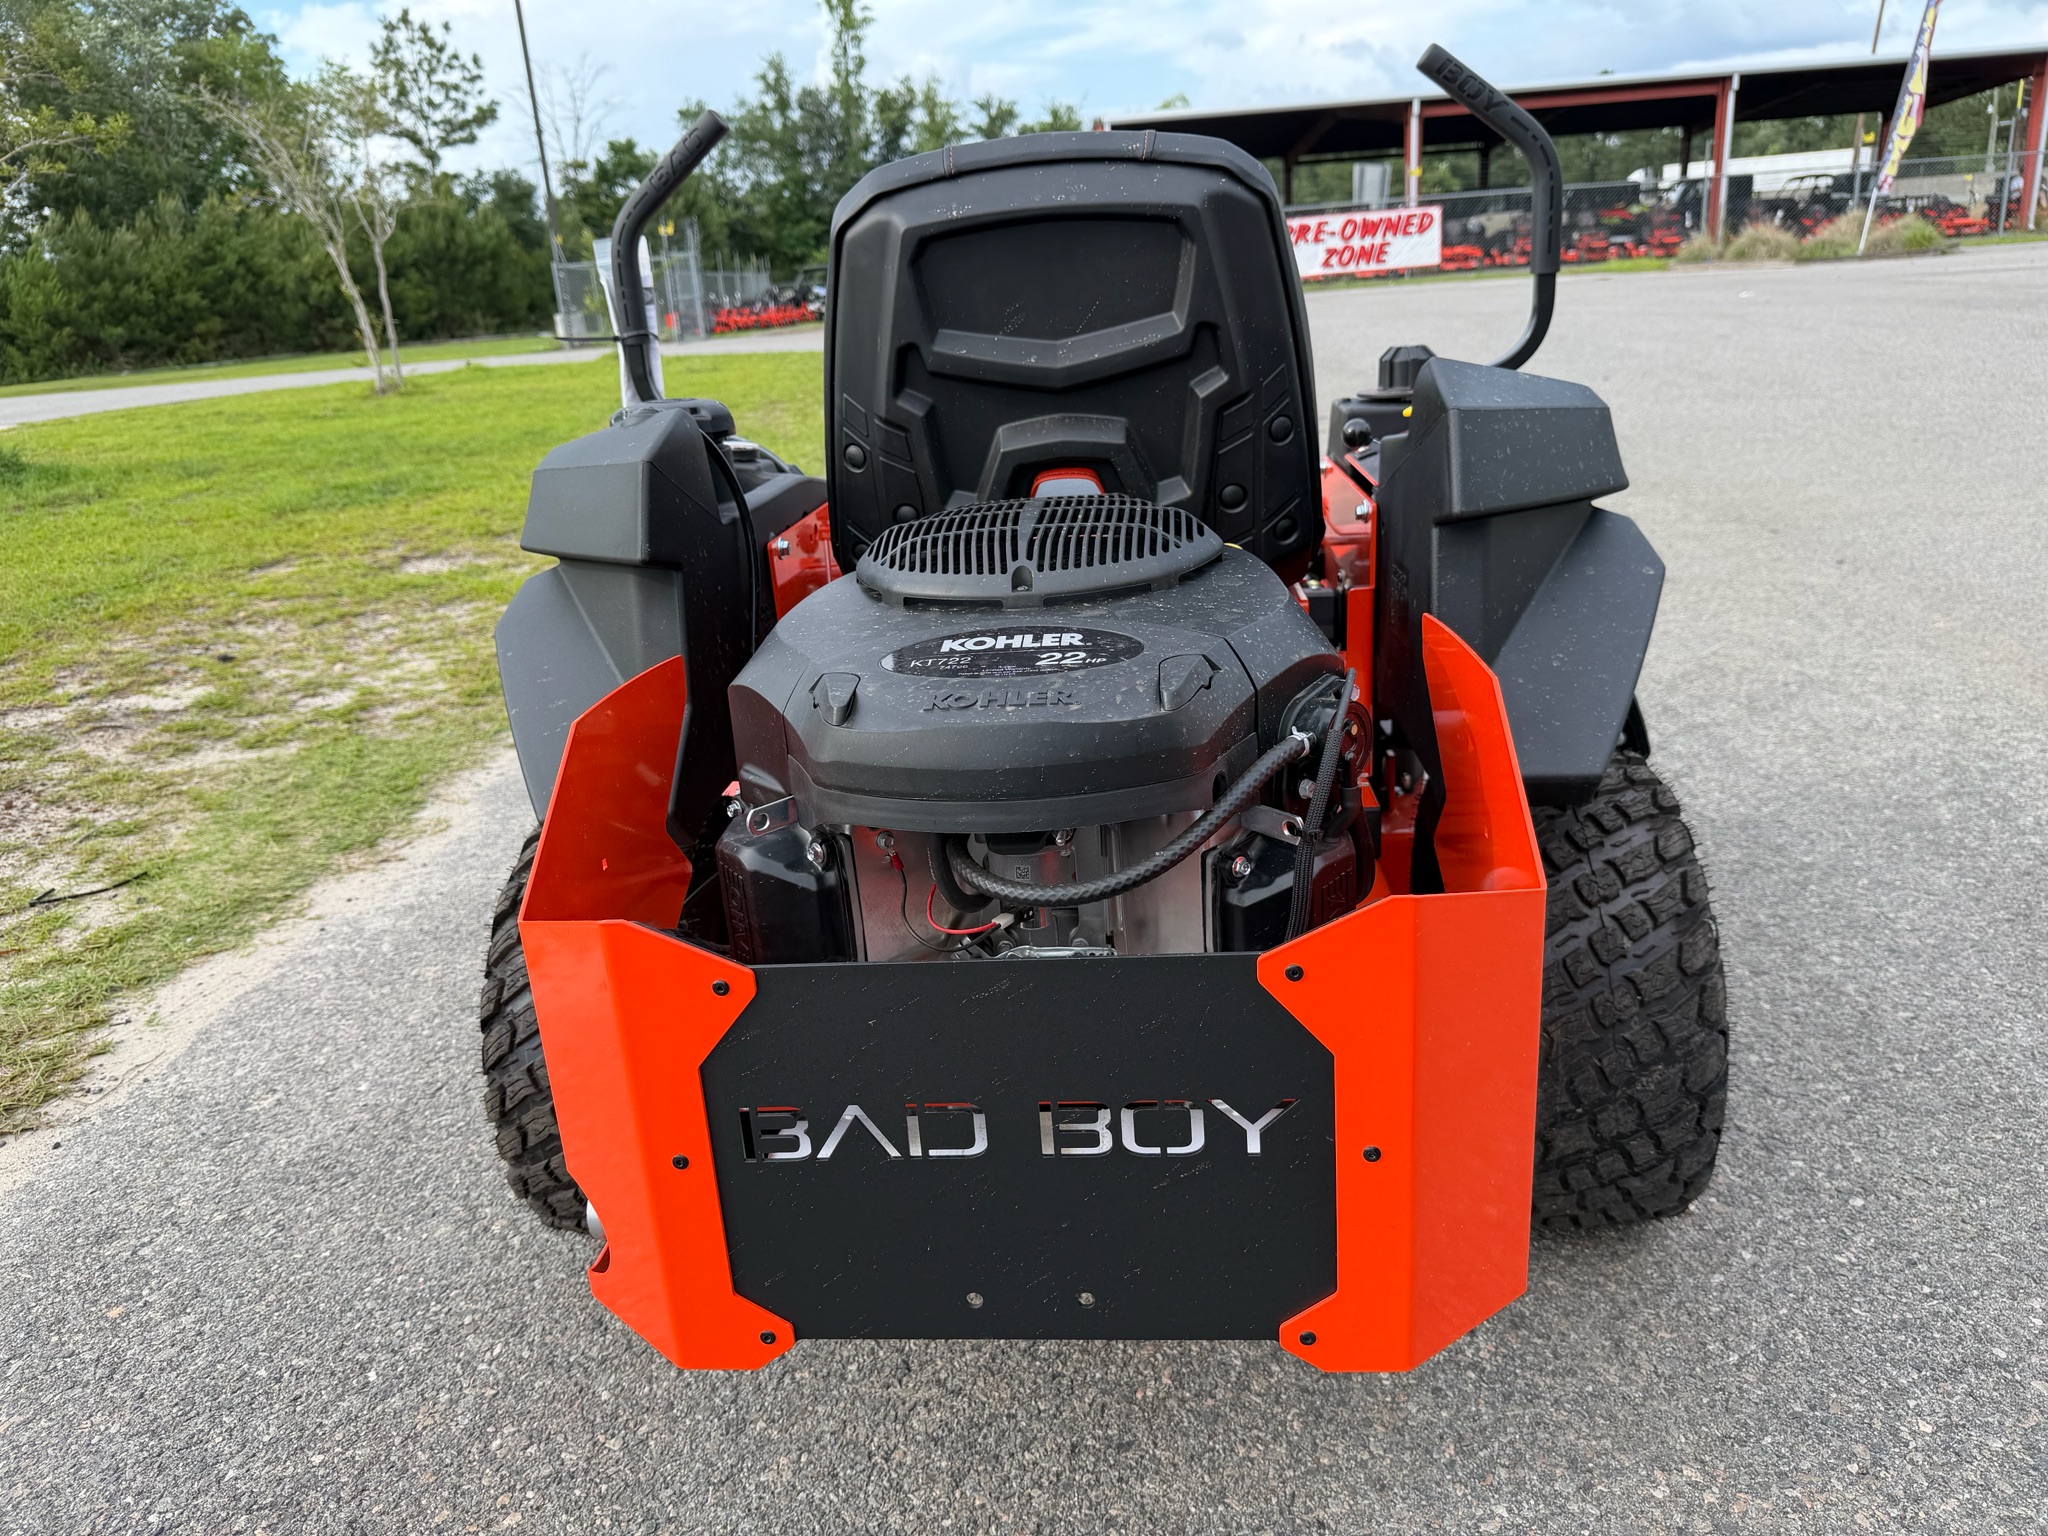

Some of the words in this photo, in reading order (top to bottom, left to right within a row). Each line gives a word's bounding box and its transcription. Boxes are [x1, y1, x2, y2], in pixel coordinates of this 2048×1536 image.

[1435, 58, 1509, 112] BOY
[1321, 242, 1391, 268] ZONE
[940, 632, 1086, 653] KOHLER
[910, 656, 972, 668] KT722
[1035, 651, 1087, 666] 22
[923, 689, 1076, 712] KOHLER
[738, 1102, 988, 1162] BAD
[1037, 1098, 1300, 1158] BOY
